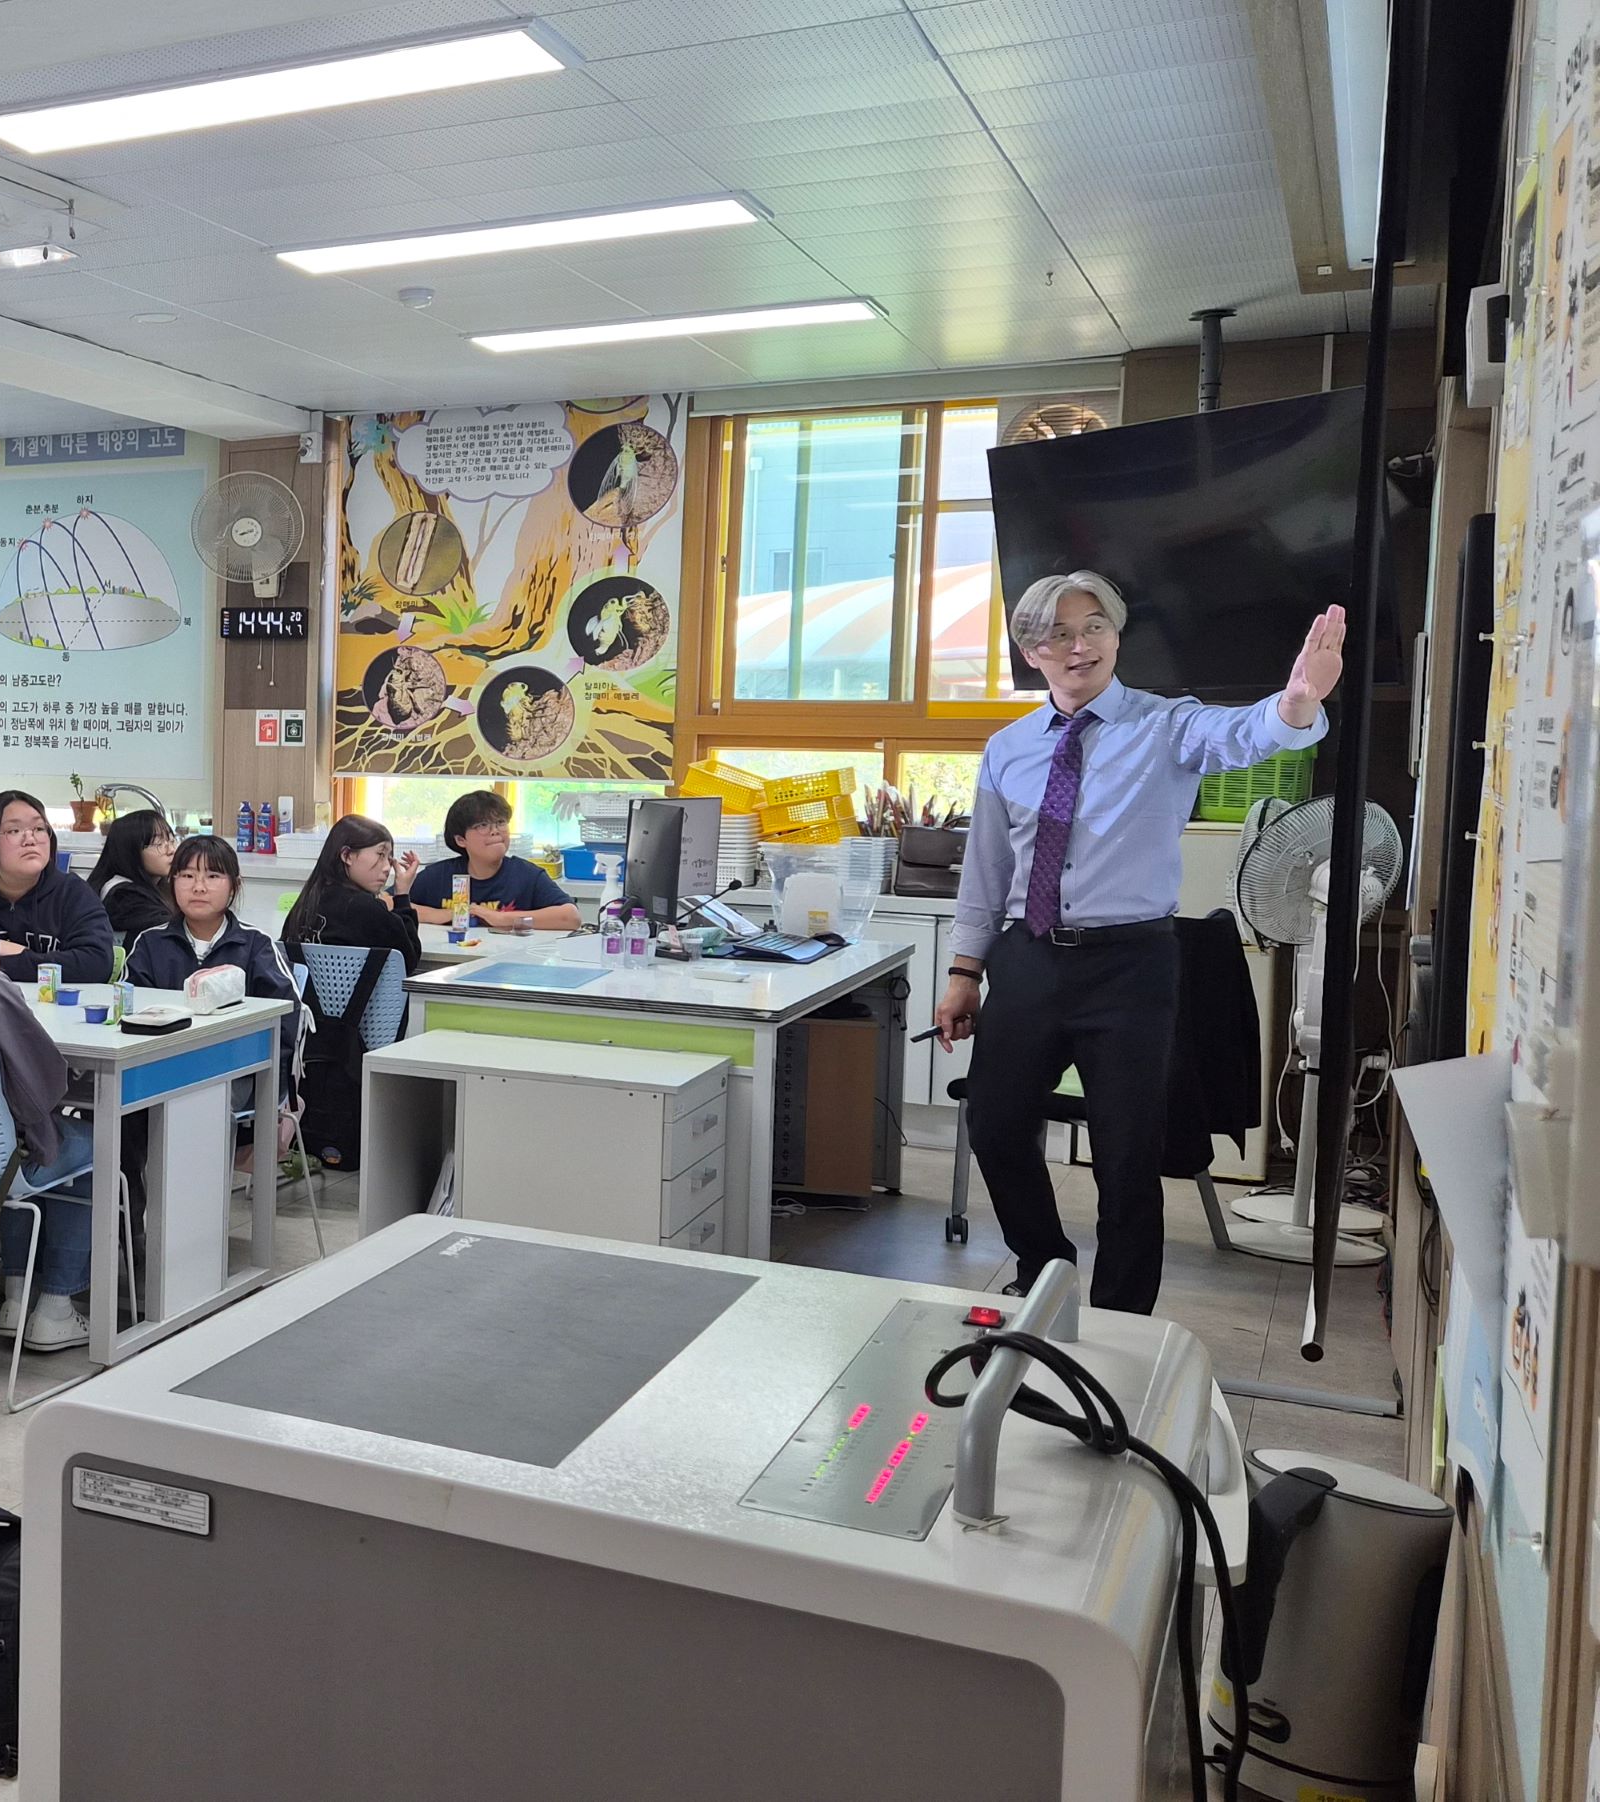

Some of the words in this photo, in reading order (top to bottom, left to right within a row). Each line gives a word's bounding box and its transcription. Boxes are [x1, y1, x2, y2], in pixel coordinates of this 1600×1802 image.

[12, 436, 52, 457] 계절에
[61, 433, 88, 455] 따른
[98, 430, 139, 452] 태양의
[148, 428, 177, 448] 고도
[76, 494, 93, 504] 하지
[0, 537, 16, 547] 동지
[184, 617, 192, 626] 북
[62, 652, 70, 662] 동
[12, 674, 62, 688] 남중고도란?
[613, 692, 640, 701] 애벌레
[12, 701, 38, 713] 고도가
[43, 702, 61, 714] 하루
[65, 702, 75, 714] 중
[79, 702, 97, 715] 가장
[101, 702, 120, 715] 높을
[124, 702, 143, 715] 때를
[147, 703, 188, 717] 말합니다.
[10, 718, 45, 731] 정남쪽에
[49, 718, 66, 731] 위치
[70, 719, 79, 732] 할
[84, 719, 112, 733] 때이며,
[116, 720, 152, 733] 그림자의
[157, 721, 184, 733] 길이가
[24, 736, 59, 748] 정북쪽을
[64, 737, 112, 750] 가리킵니다.
